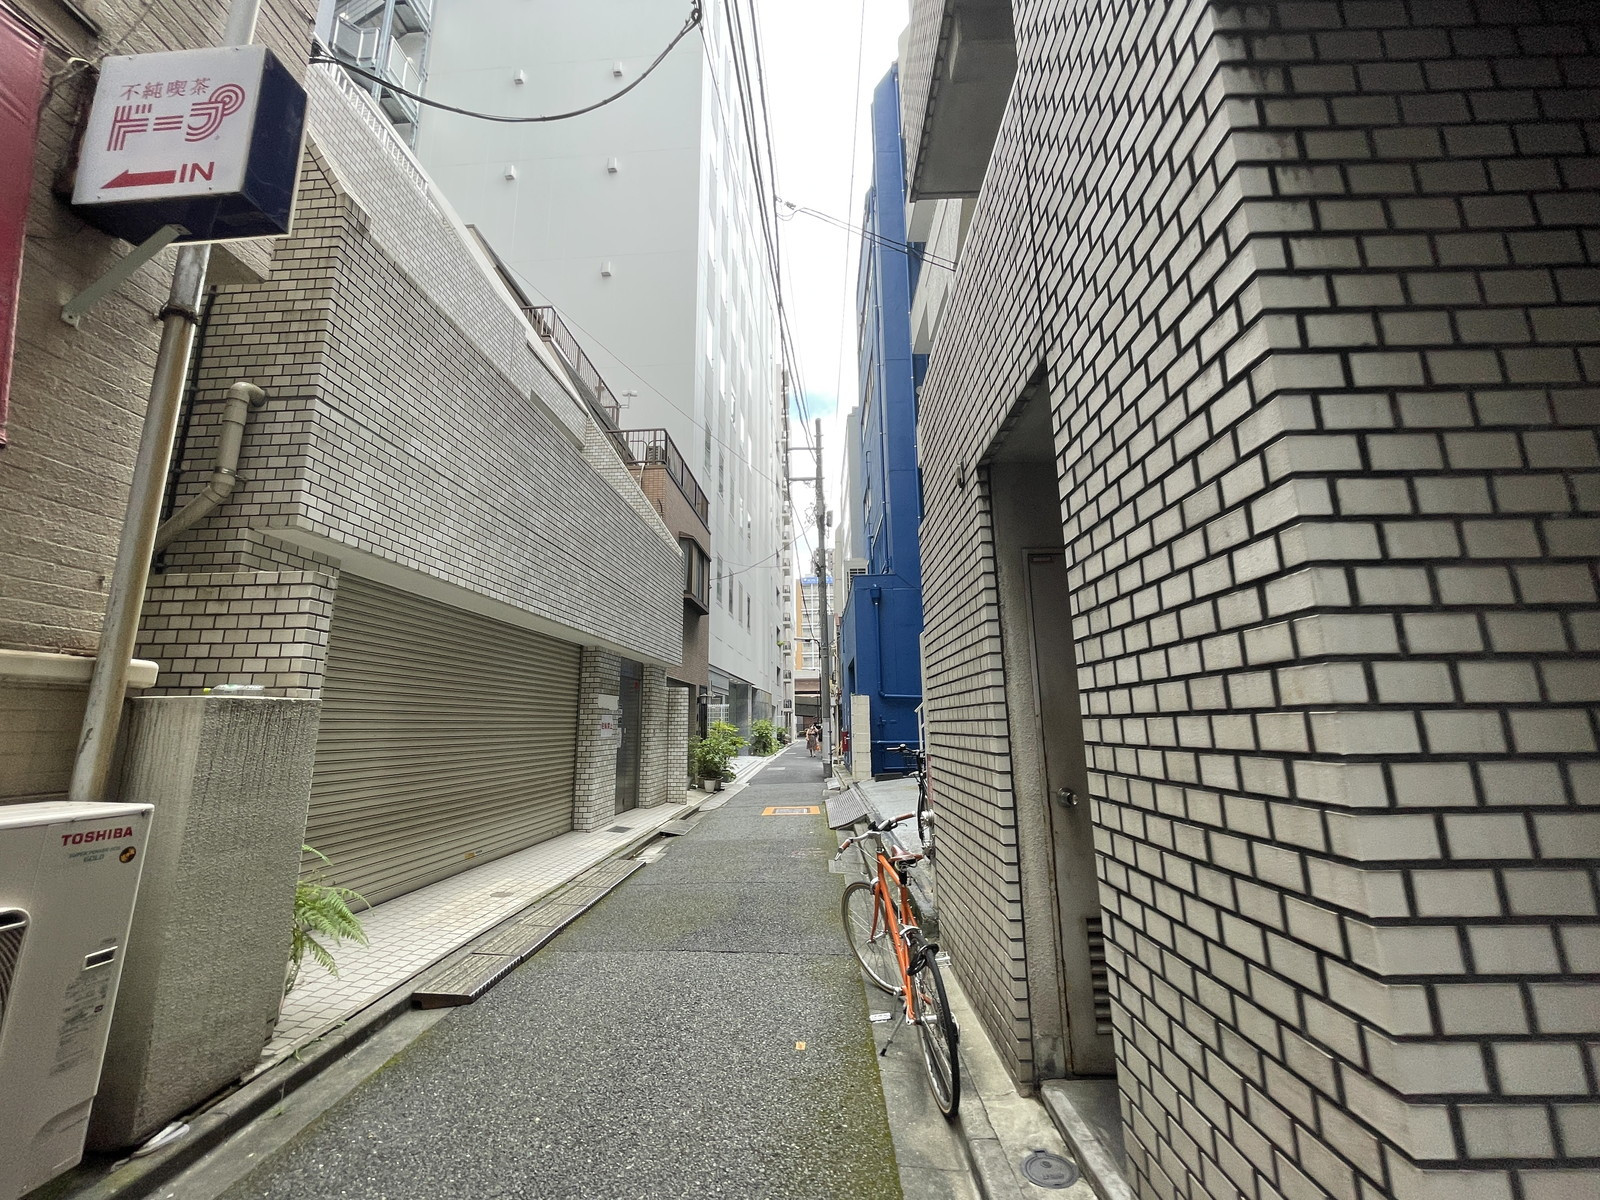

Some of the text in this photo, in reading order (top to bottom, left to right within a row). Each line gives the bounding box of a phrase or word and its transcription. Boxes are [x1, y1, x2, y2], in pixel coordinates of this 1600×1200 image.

[120, 78, 211, 101] 不純喫茶
[106, 83, 246, 152] ドープ
[179, 161, 215, 183] IN
[61, 826, 133, 847] TOSHIBA
